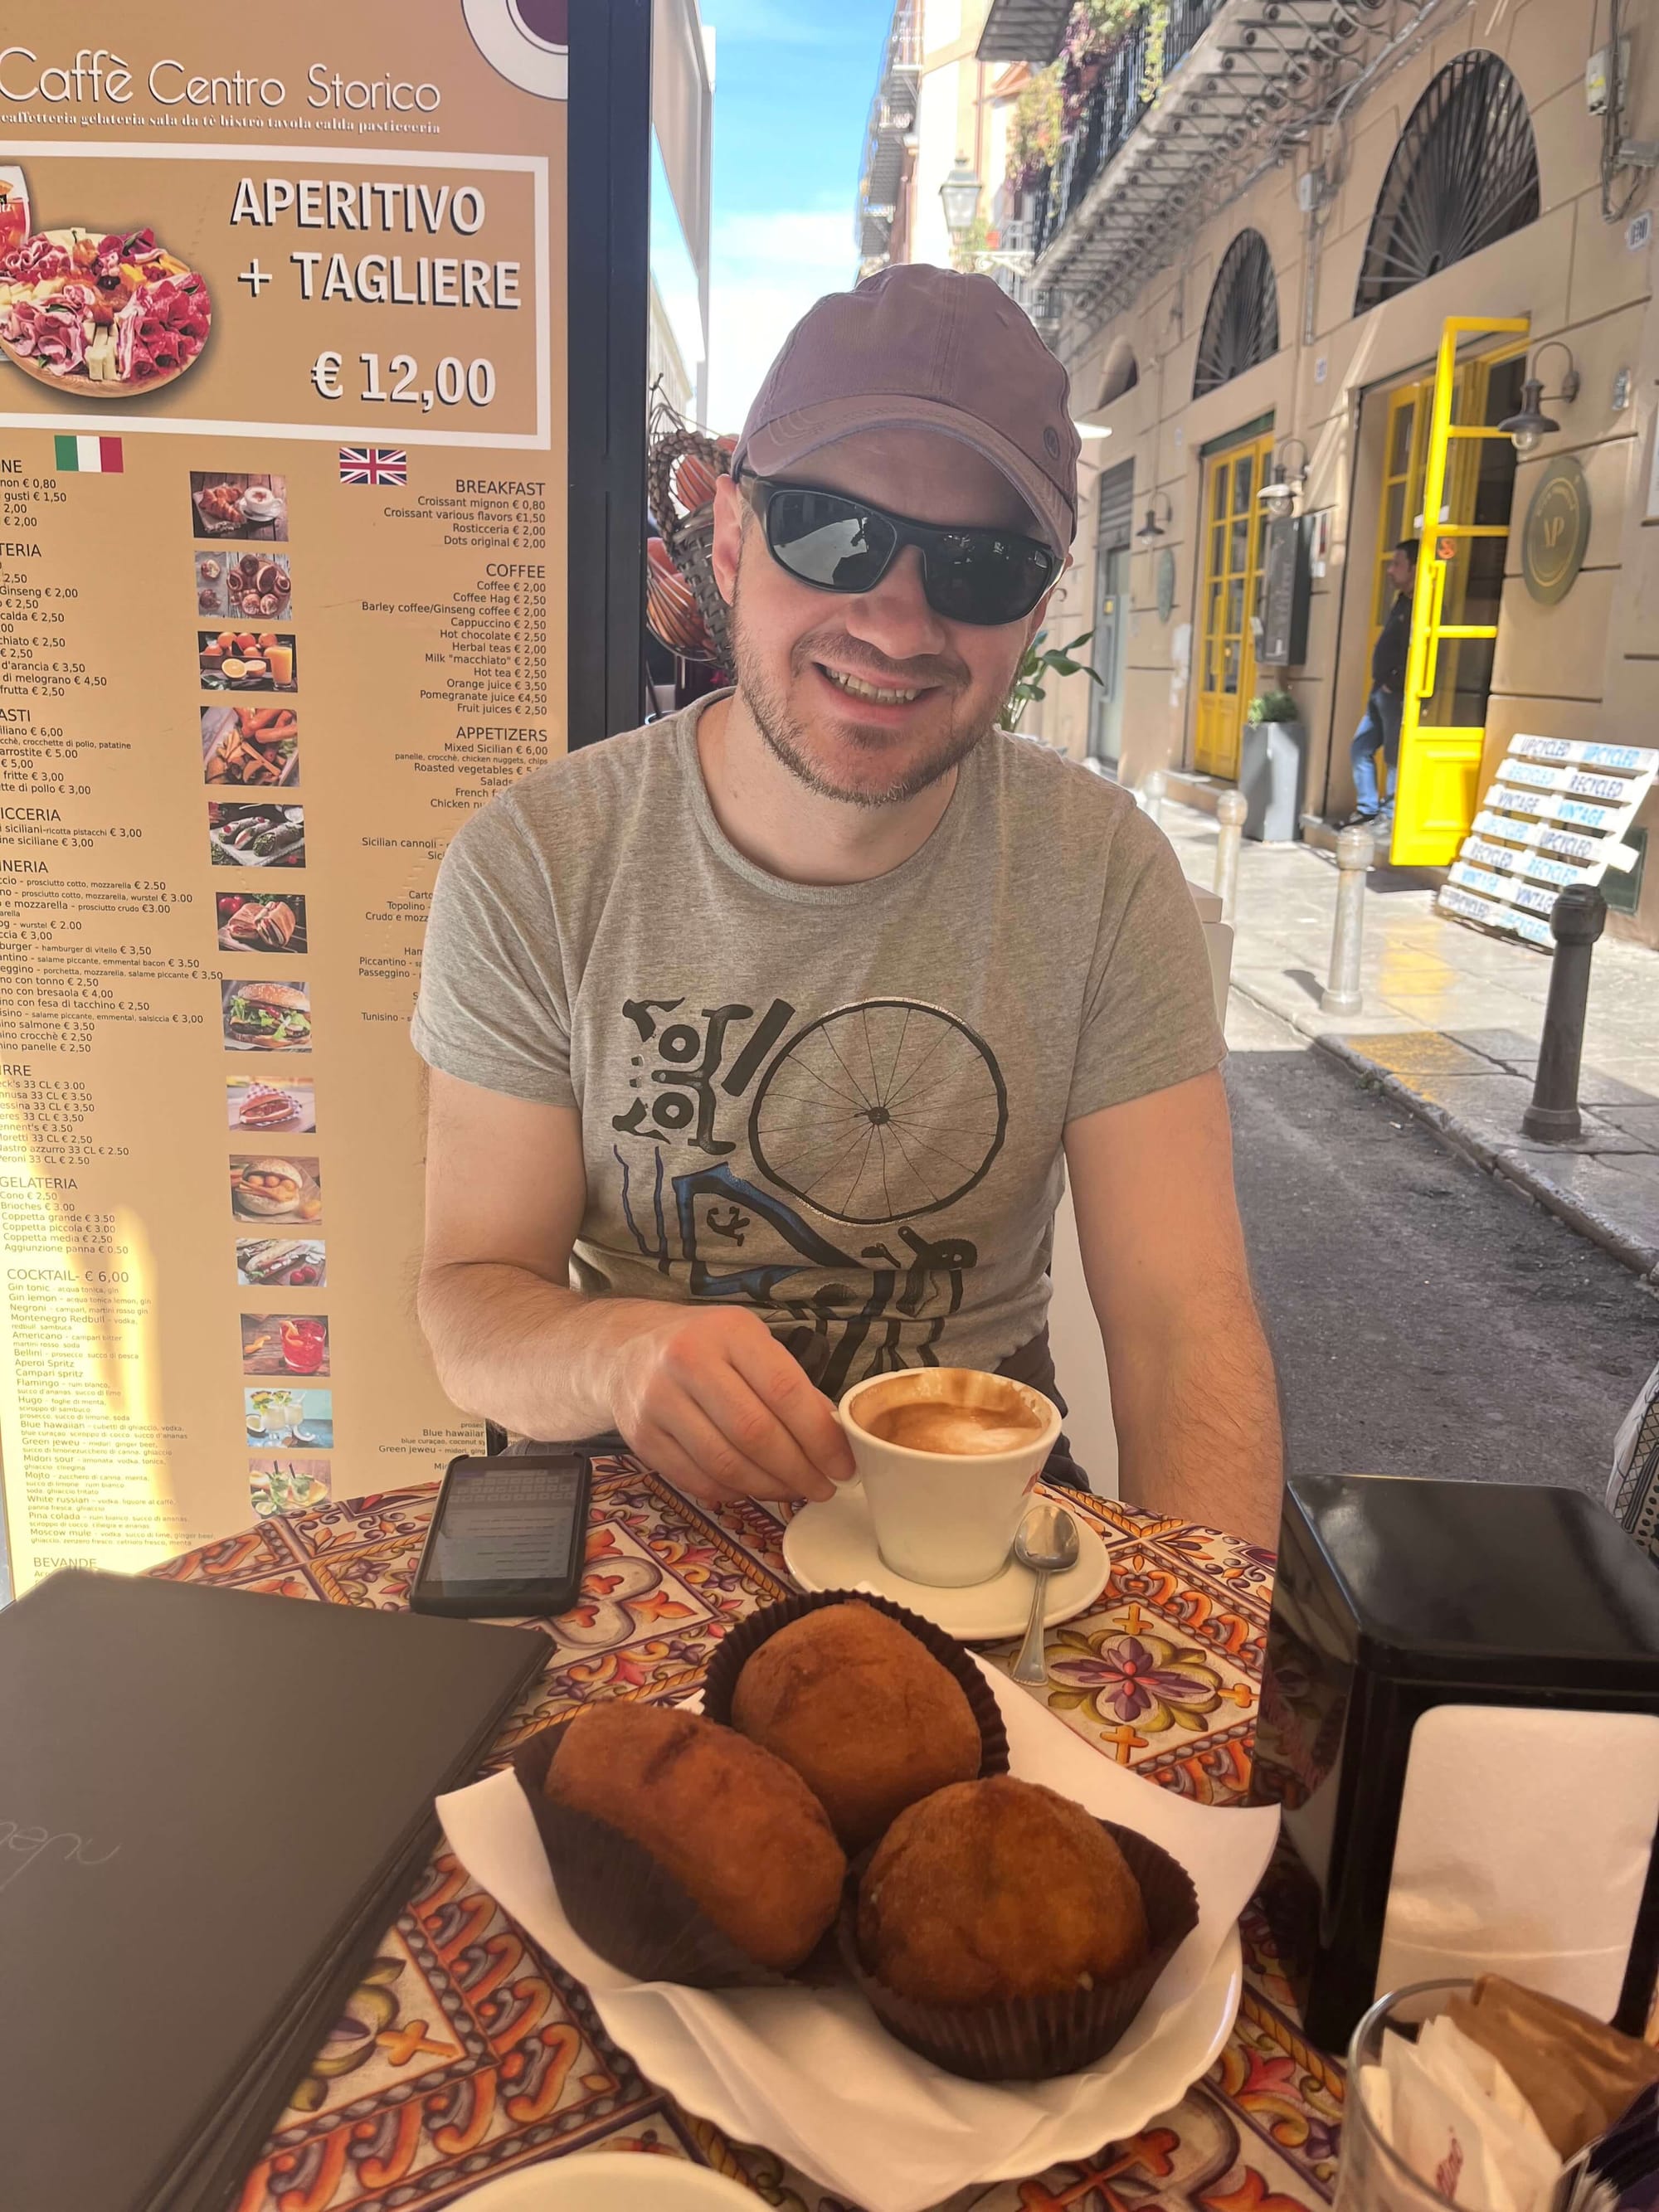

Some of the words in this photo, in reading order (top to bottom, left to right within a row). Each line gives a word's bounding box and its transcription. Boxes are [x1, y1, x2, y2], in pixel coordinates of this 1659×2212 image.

[0, 46, 134, 103] Caffè
[148, 59, 286, 106] Centro
[306, 62, 441, 113] Storico
[0, 111, 76, 124] caffetteria
[80, 112, 145, 127] gelateria
[148, 114, 178, 126] sala
[181, 114, 200, 126] da
[202, 114, 216, 126] tè
[219, 114, 264, 128] bistrò
[267, 117, 312, 129] tavola
[315, 118, 355, 131] calda
[358, 119, 440, 134] pasticceria
[231, 177, 486, 235] APERITIVO
[238, 258, 273, 298] +
[290, 251, 522, 309] TAGLIERE
[311, 351, 344, 401] €
[360, 352, 497, 412] 12,00
[456, 479, 546, 496] BREAKFAST
[417, 496, 467, 508] Croissant
[470, 498, 509, 510] mignon
[513, 499, 519, 509] €
[522, 500, 545, 511] 0,80
[384, 507, 433, 518] Croissant
[435, 509, 474, 520] various
[477, 511, 513, 522] flavors
[453, 523, 509, 534] Rosticceria
[513, 525, 519, 535] €
[523, 525, 546, 537] 2,00
[444, 535, 468, 546] Dots
[471, 536, 509, 548] original
[513, 537, 519, 547] €
[523, 538, 546, 549] 2,00
[486, 563, 545, 578] COFFEE
[477, 581, 510, 591] Coffee
[513, 582, 520, 591] €
[523, 582, 546, 593] 2,00
[453, 592, 487, 603] Coffee
[490, 594, 510, 605] Hag
[513, 595, 520, 604] €
[523, 595, 546, 605] 2,50
[362, 601, 395, 614] Barley
[398, 603, 475, 617] coffee/Ginseng
[479, 606, 510, 616] coffee
[513, 607, 520, 616] €
[523, 607, 546, 618] 2,00
[450, 617, 511, 630] Cappuccino
[513, 620, 520, 629] €
[523, 620, 547, 630] 2,50
[440, 630, 458, 639] Hot
[461, 630, 511, 641] chocolate
[513, 632, 520, 641] €
[524, 632, 547, 642] 2,50
[452, 642, 486, 652] Herbal
[489, 644, 511, 653] teas
[514, 644, 521, 654] €
[524, 644, 547, 655] 2,00
[426, 653, 445, 663] Milk
[449, 654, 511, 665] "macchiato"
[514, 656, 521, 666] €
[524, 656, 547, 667] 2,50
[2, 673, 12, 682] di
[15, 673, 71, 686] melograno
[74, 675, 80, 685] €
[84, 676, 107, 686] 4,50
[474, 668, 492, 677] Hot
[494, 668, 511, 678] tea
[514, 668, 521, 678] €
[524, 668, 547, 679] 2,50
[446, 678, 484, 691] Orange
[487, 679, 512, 691] juice
[514, 681, 521, 690] €
[524, 681, 547, 692] 3,50
[420, 690, 488, 702] Pomegranate
[490, 692, 515, 703] juice
[457, 702, 479, 712] Fruit
[483, 704, 512, 715] juices
[515, 705, 521, 714] €
[525, 705, 547, 716] 2,50
[456, 726, 547, 742] APPETIZERS
[22, 738, 64, 746] crocchette
[445, 742, 474, 752] Mixed
[477, 744, 513, 754] Sicilian
[516, 745, 523, 755] €
[526, 746, 548, 756] 6,00
[1520, 741, 1571, 757] UPCYCLED
[461, 755, 491, 763] chicken
[414, 762, 455, 773] Roasted
[458, 766, 513, 775] vegetables
[455, 788, 489, 798] French
[1571, 774, 1624, 799] RECYCLED
[431, 799, 470, 809] Chicken
[1497, 790, 1540, 813] VINTAGE
[1558, 800, 1606, 825] VINTAGE
[109, 828, 116, 837] €
[119, 828, 142, 838] 3,00
[362, 837, 397, 847] Sicilian
[401, 839, 436, 848] cannoli
[1539, 831, 1593, 856] UPCYCLED
[1470, 842, 1514, 868] RECYCLED
[1526, 858, 1579, 884] RECYCLED
[387, 901, 426, 912] Topolino
[365, 912, 393, 921] Crudo
[359, 956, 406, 966] Piccantino
[358, 968, 410, 979] Passeggino
[37, 998, 58, 1008] fesa
[61, 999, 71, 1008] di
[74, 1000, 115, 1009] tacchino
[119, 1001, 124, 1010] €
[361, 1012, 398, 1022] Tunisino
[0, 1176, 78, 1189] GELATERIA
[2, 1212, 45, 1222] Coppetta
[48, 1213, 82, 1223] grande
[2, 1222, 46, 1232] Coppetta
[49, 1223, 83, 1232] piccola
[85, 1271, 93, 1281] €
[99, 1271, 129, 1283] 6,00
[423, 1428, 443, 1437] Blue
[33, 1557, 96, 1568] BEVANDE
